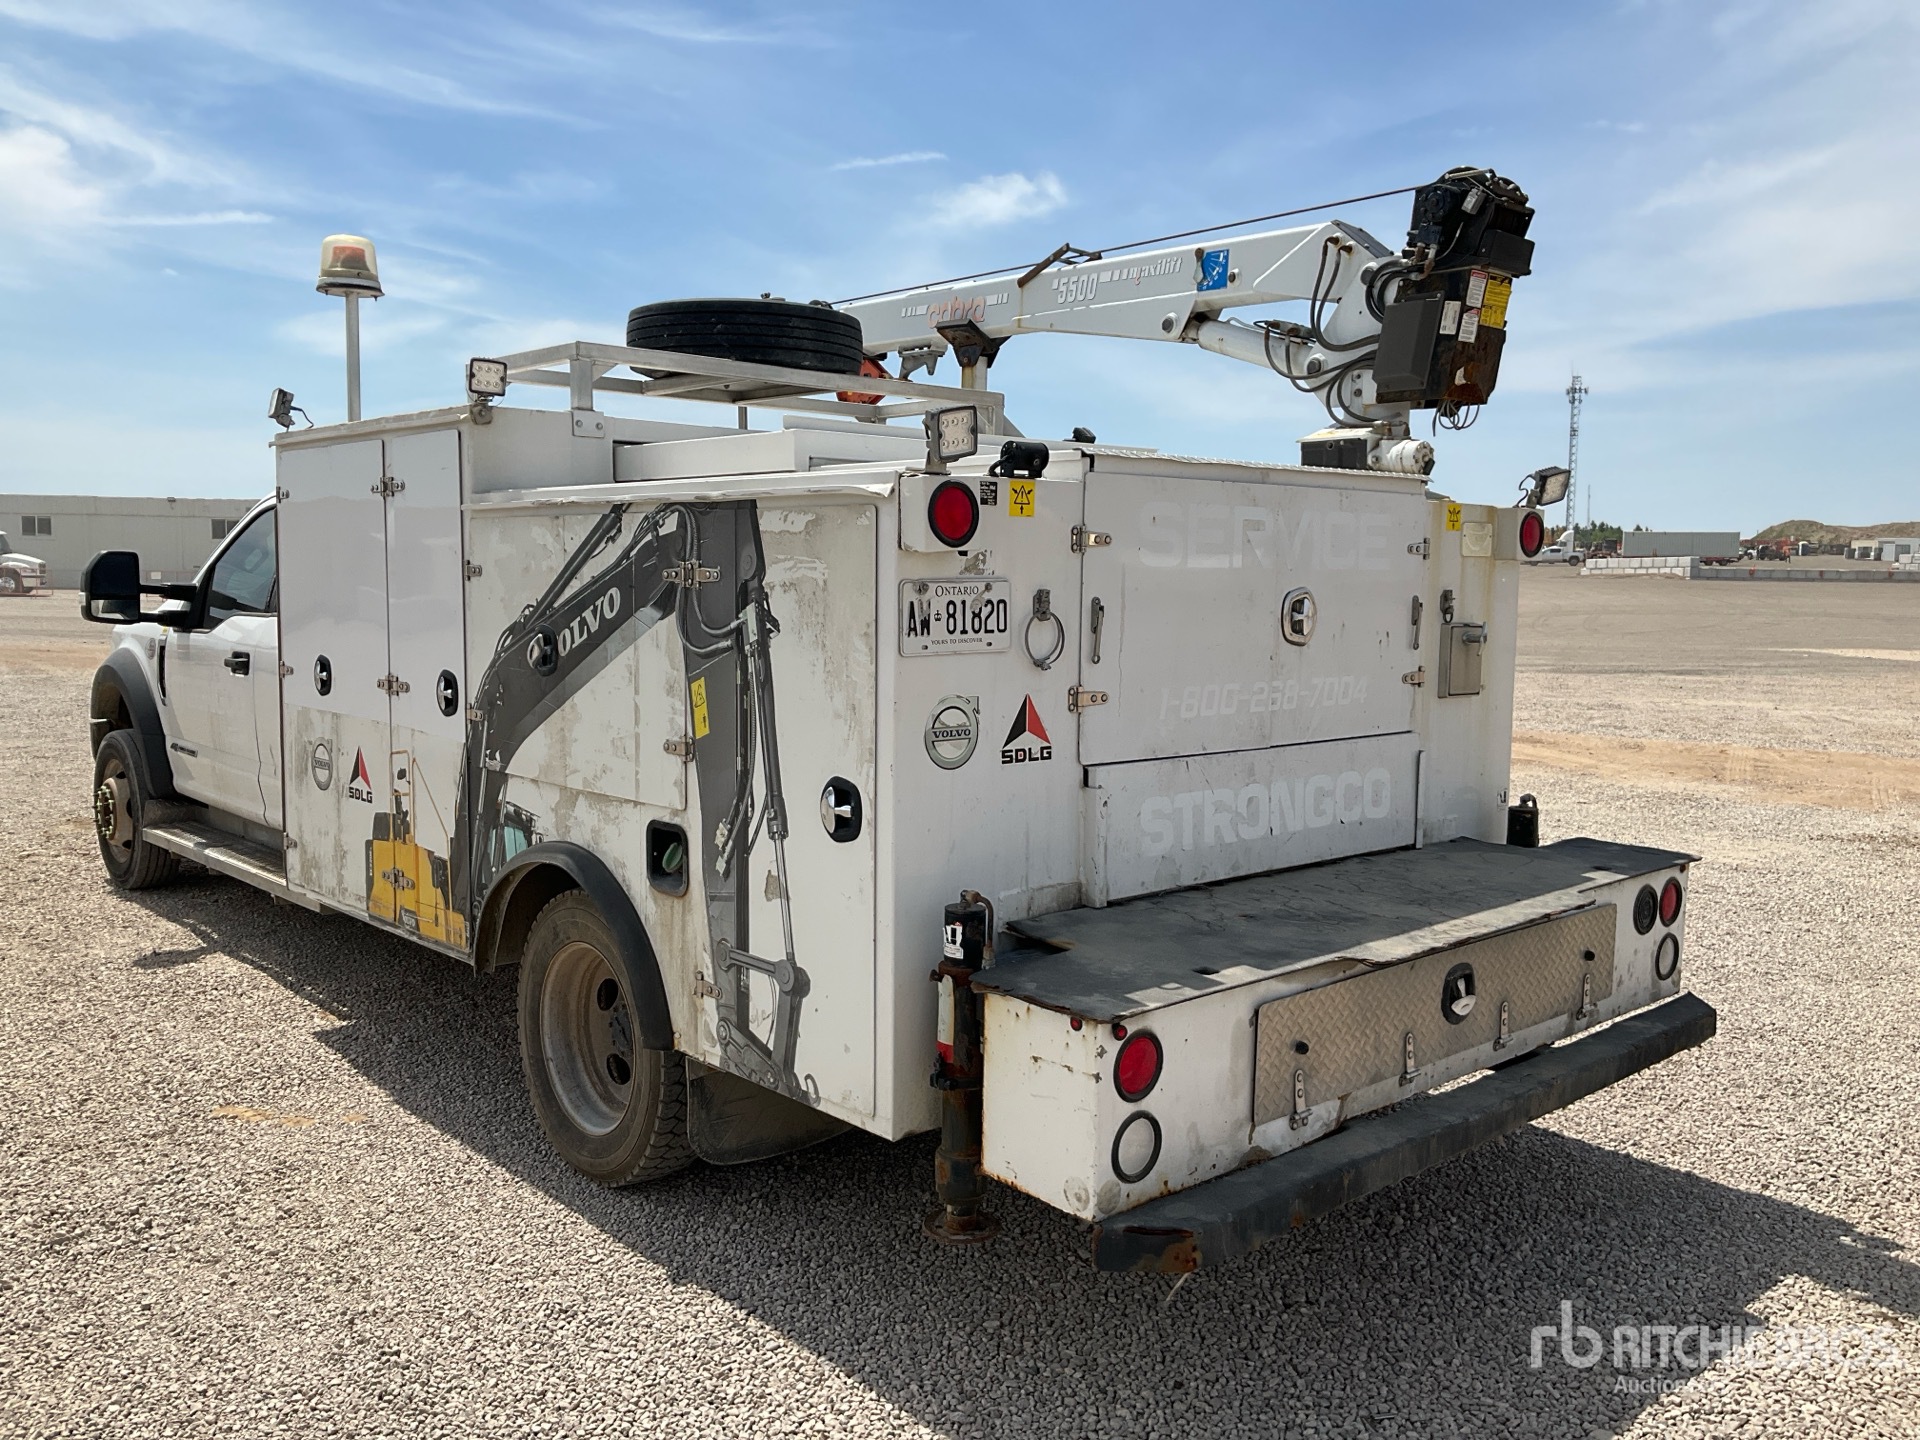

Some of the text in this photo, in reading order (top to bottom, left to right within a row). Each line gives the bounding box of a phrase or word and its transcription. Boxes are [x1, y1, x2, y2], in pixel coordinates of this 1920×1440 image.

[1128, 257, 1183, 286] maxilift
[1057, 273, 1099, 305] 5500
[1138, 502, 1392, 571] SERVICE
[934, 585, 980, 597] ONTARIO
[556, 586, 621, 657] OLVO
[907, 598, 1008, 638] AW 81820
[932, 728, 972, 739] VOLVO
[1001, 745, 1052, 765] SDLG
[348, 786, 373, 804] SDLG
[1140, 767, 1391, 858] STRONGCO
